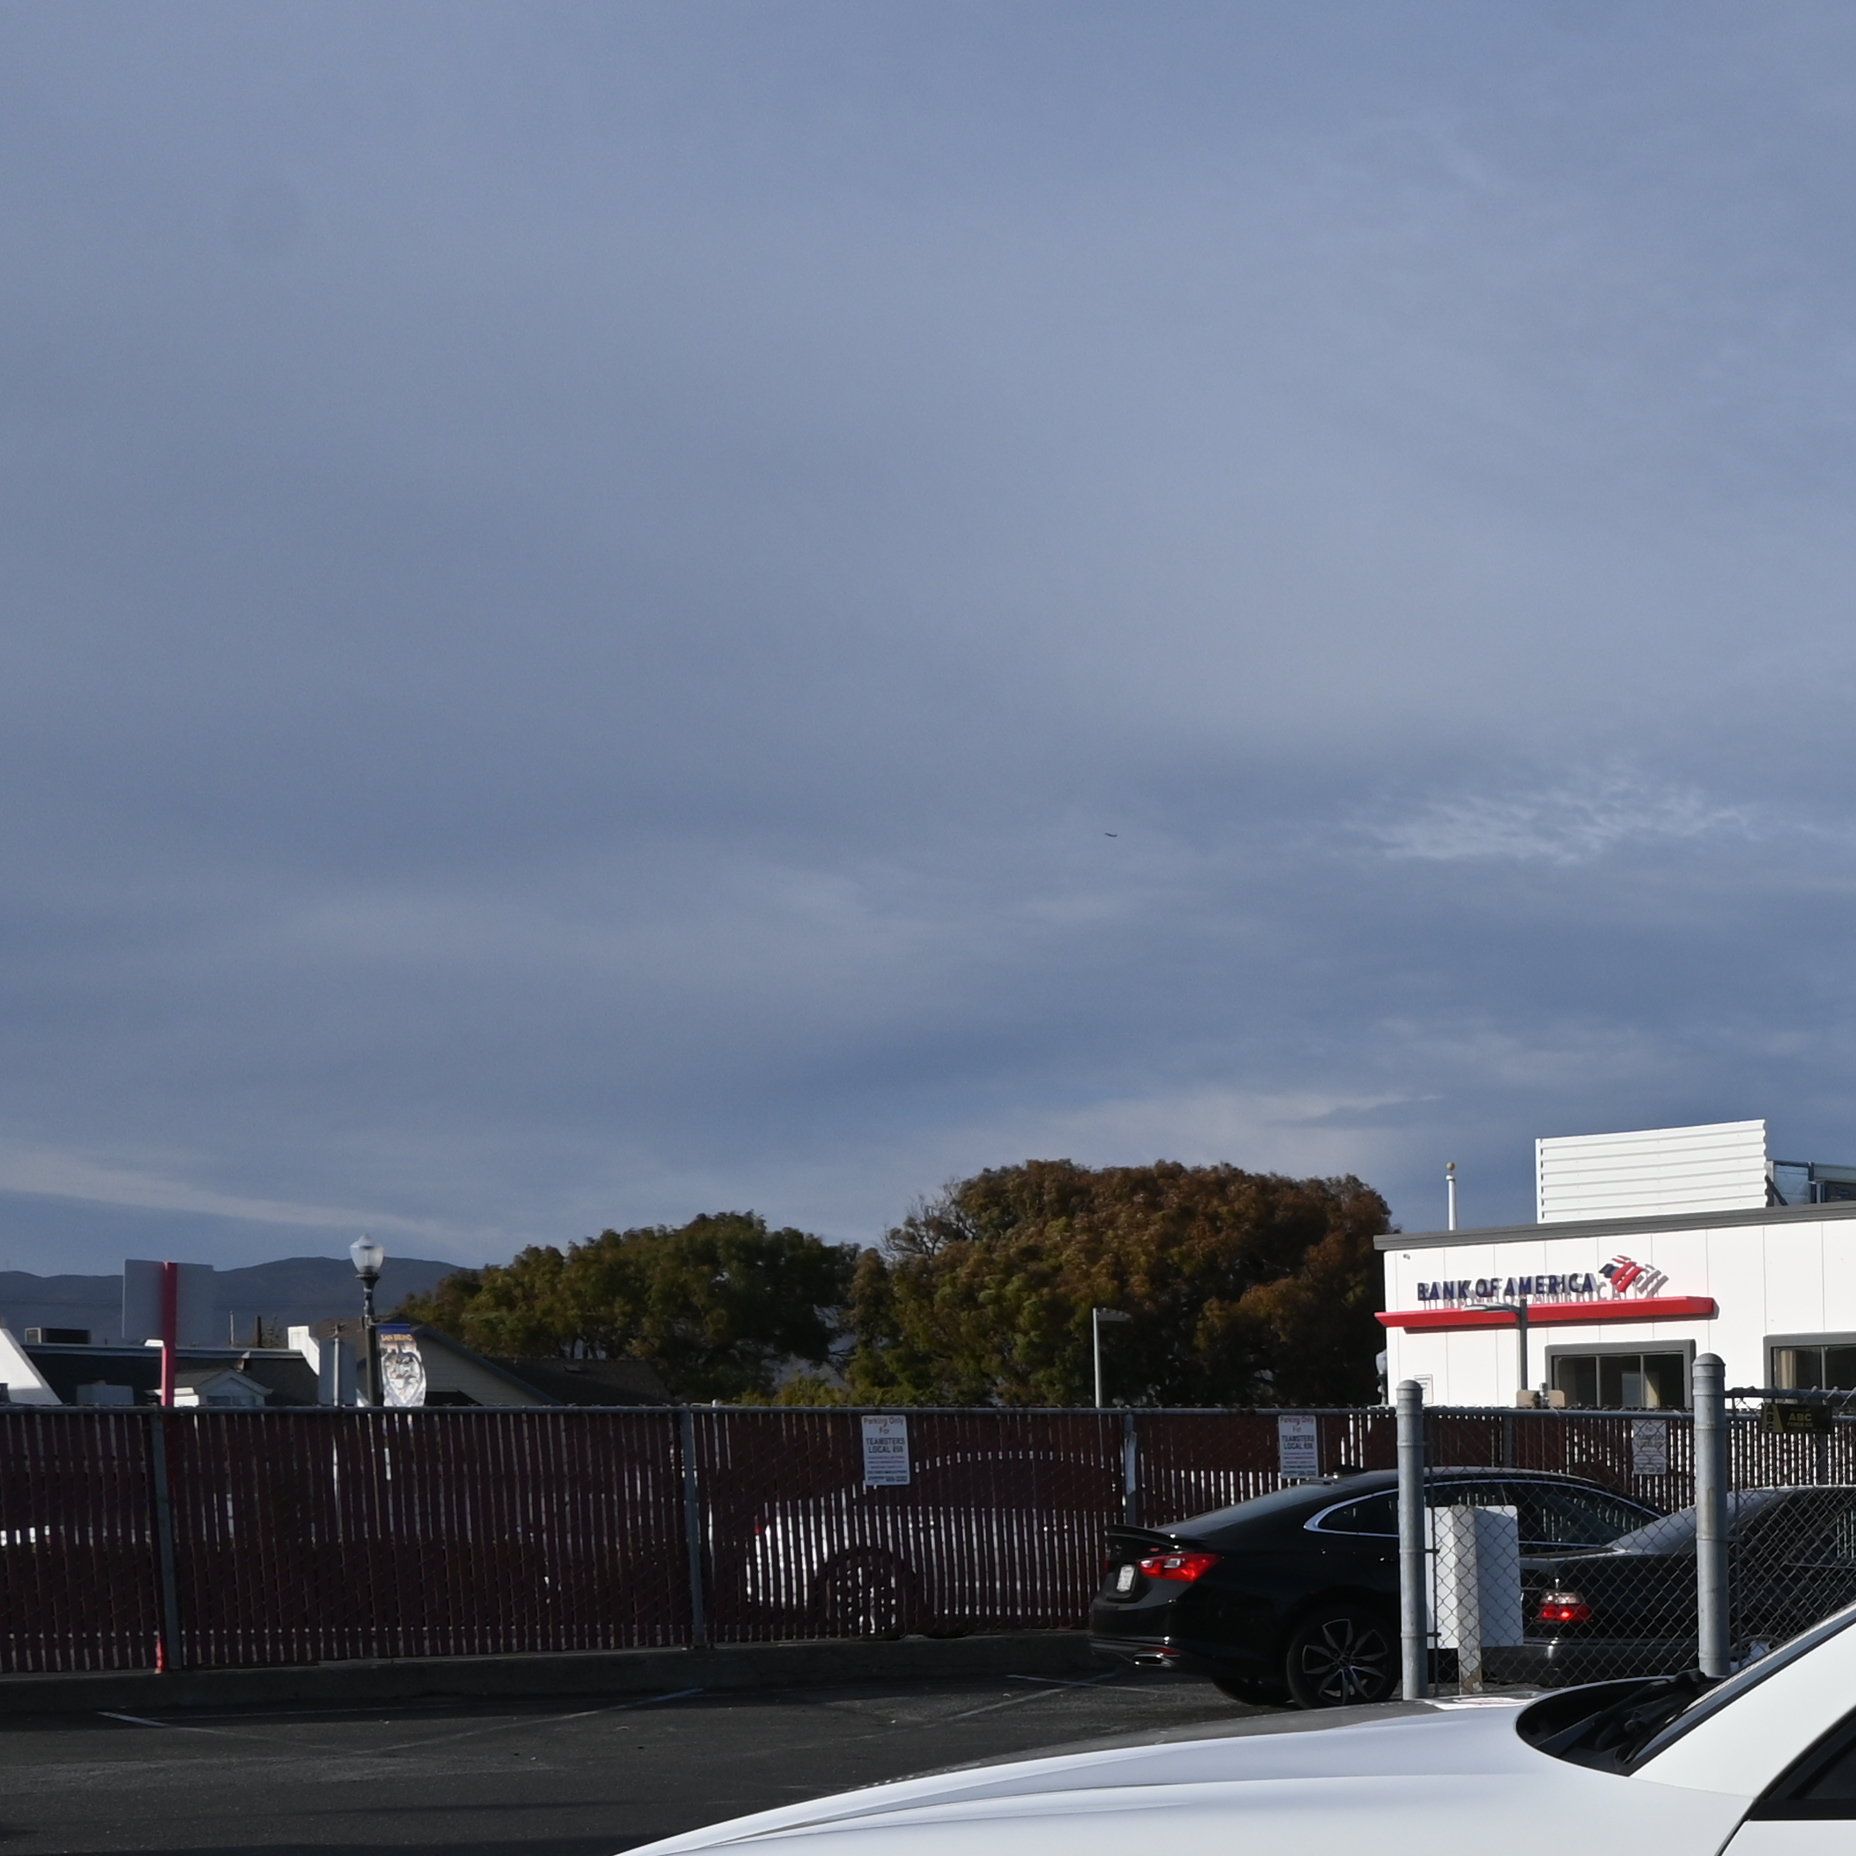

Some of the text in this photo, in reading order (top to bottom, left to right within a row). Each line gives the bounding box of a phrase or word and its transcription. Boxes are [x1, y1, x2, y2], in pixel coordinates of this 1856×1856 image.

[1417, 1272, 1594, 1301] BANK OF AMERICA
[1788, 1412, 1812, 1422] ABC
